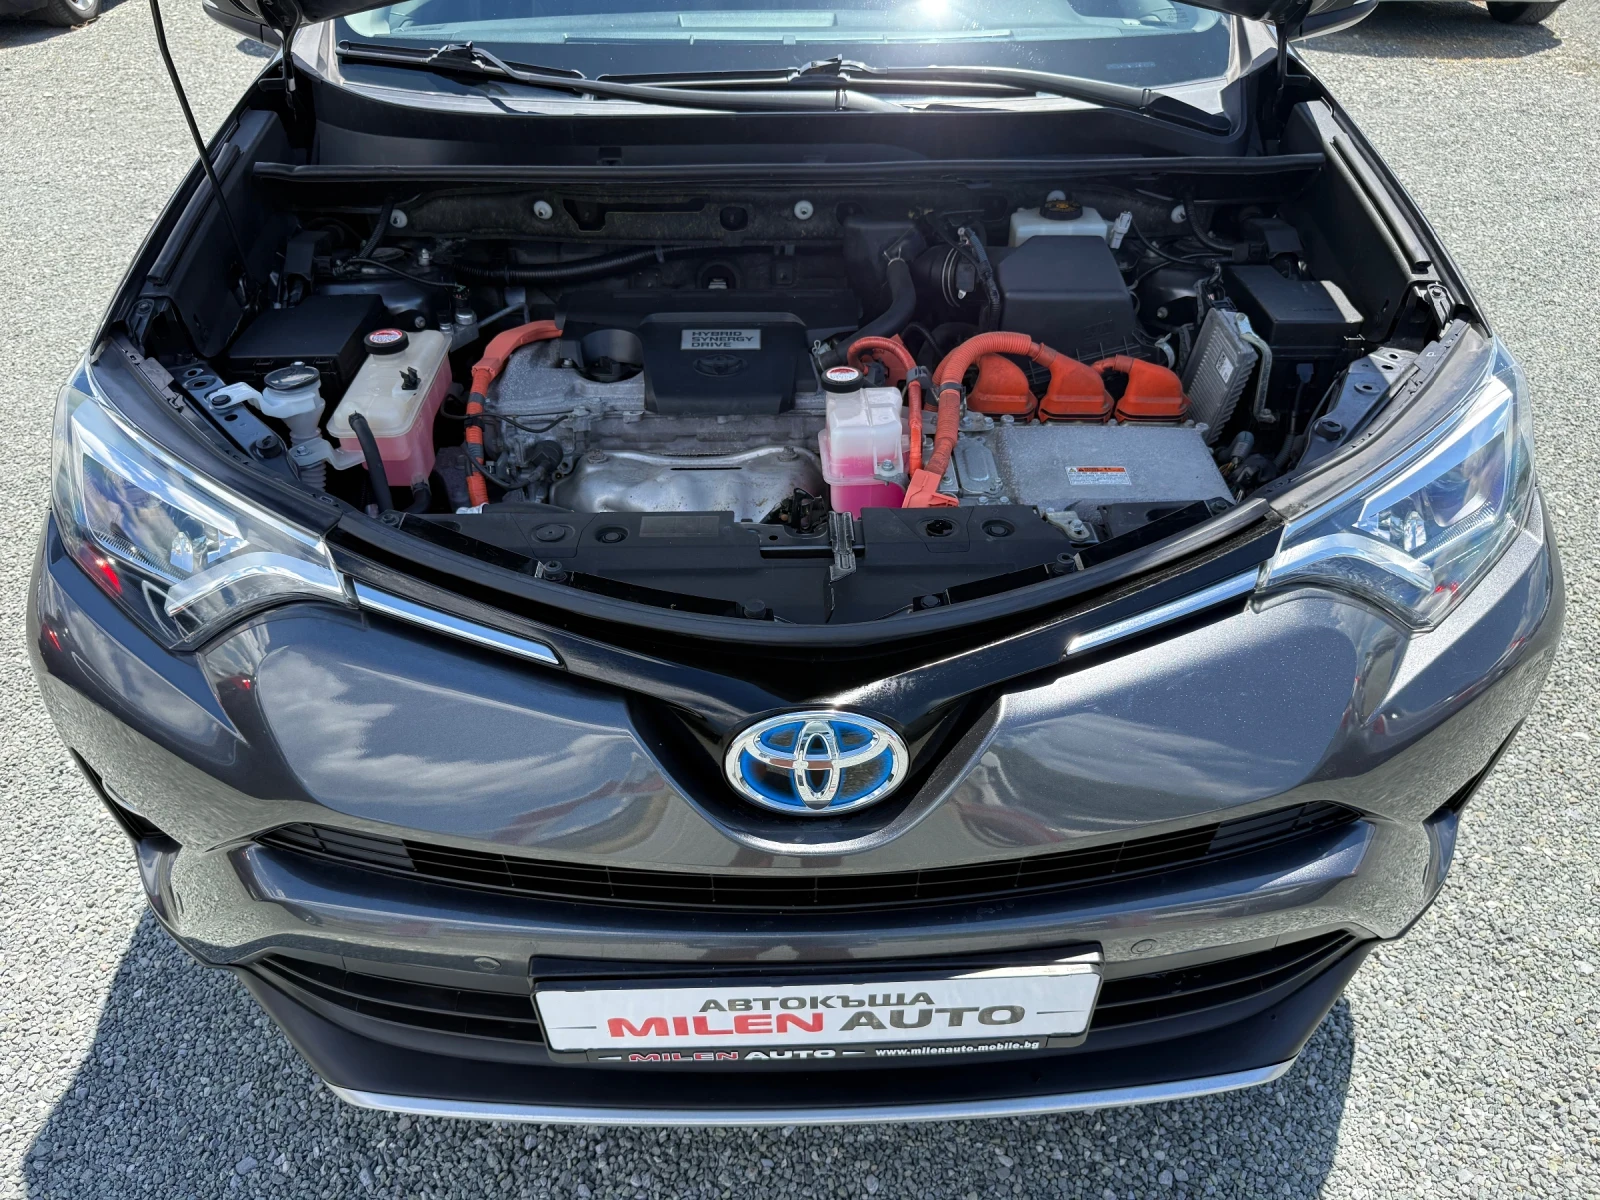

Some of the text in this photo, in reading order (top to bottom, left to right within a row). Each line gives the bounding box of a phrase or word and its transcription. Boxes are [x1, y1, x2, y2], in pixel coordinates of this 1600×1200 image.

[698, 992, 935, 1013] АВТОКЪША
[607, 1005, 1025, 1038] MILEN AUTO
[628, 1049, 836, 1062] MILEN AUTO
[875, 1040, 1040, 1057] www.milenauto.mobile.bg
